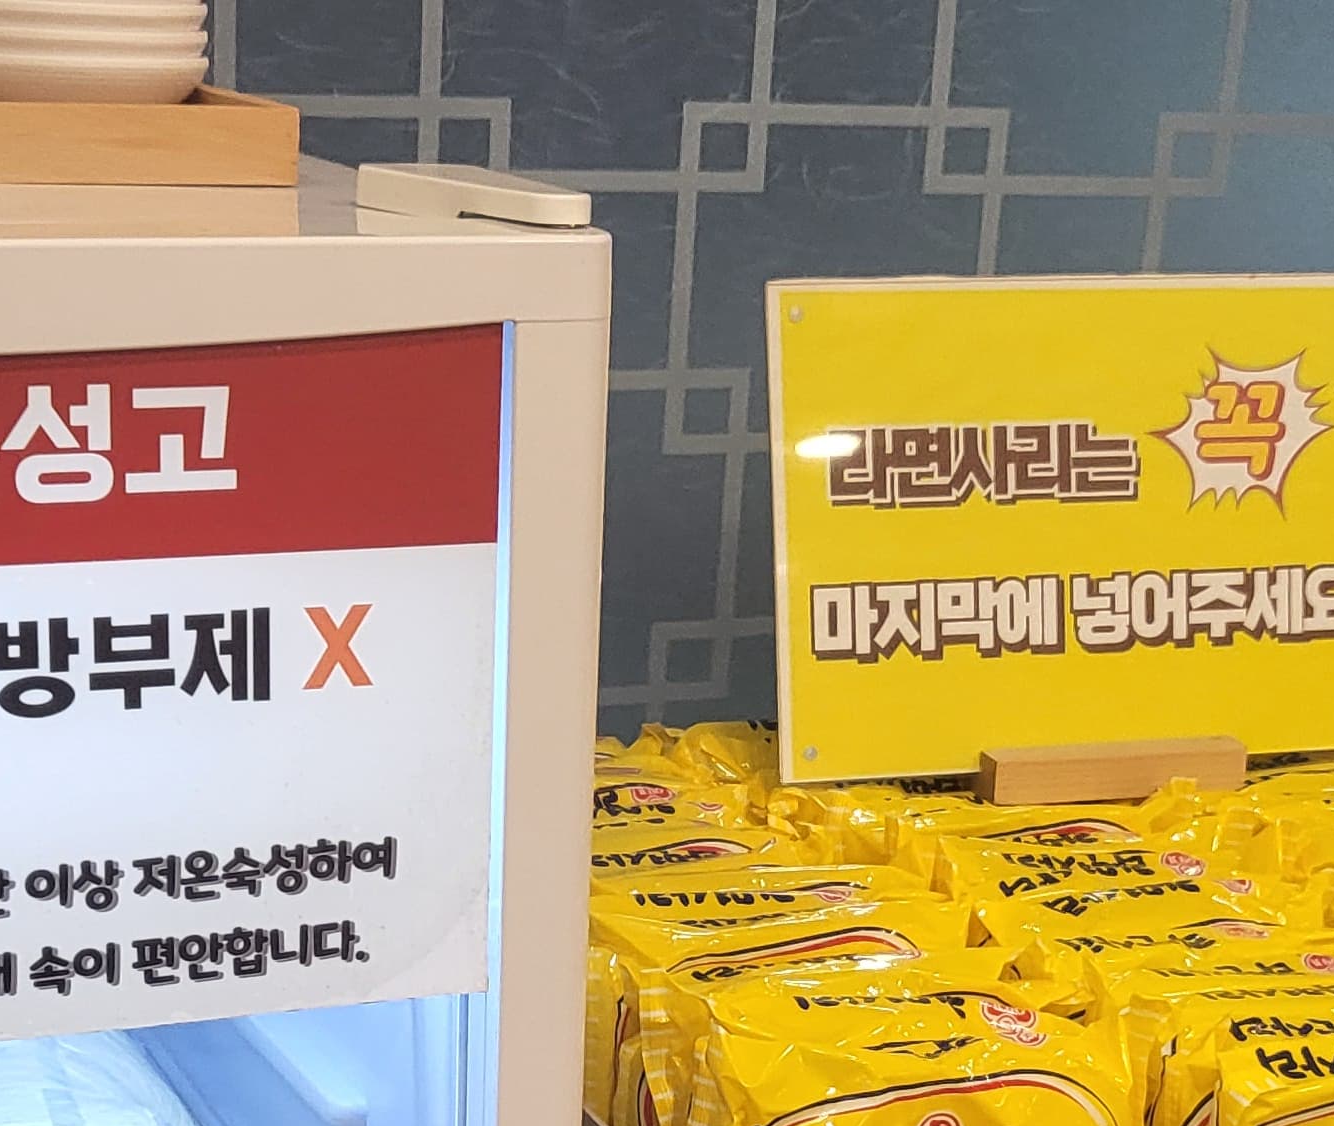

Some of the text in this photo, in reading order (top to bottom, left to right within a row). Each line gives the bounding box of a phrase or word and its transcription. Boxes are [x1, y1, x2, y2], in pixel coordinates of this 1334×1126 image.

[827, 380, 1287, 509] 라면사리는 꼭
[303, 603, 373, 690] X
[810, 576, 1066, 664] 마지막에
[25, 860, 123, 911] 이상
[133, 836, 398, 902] 저온숙성하여
[29, 941, 121, 996] 속이
[133, 919, 370, 985] 편안합니다.
